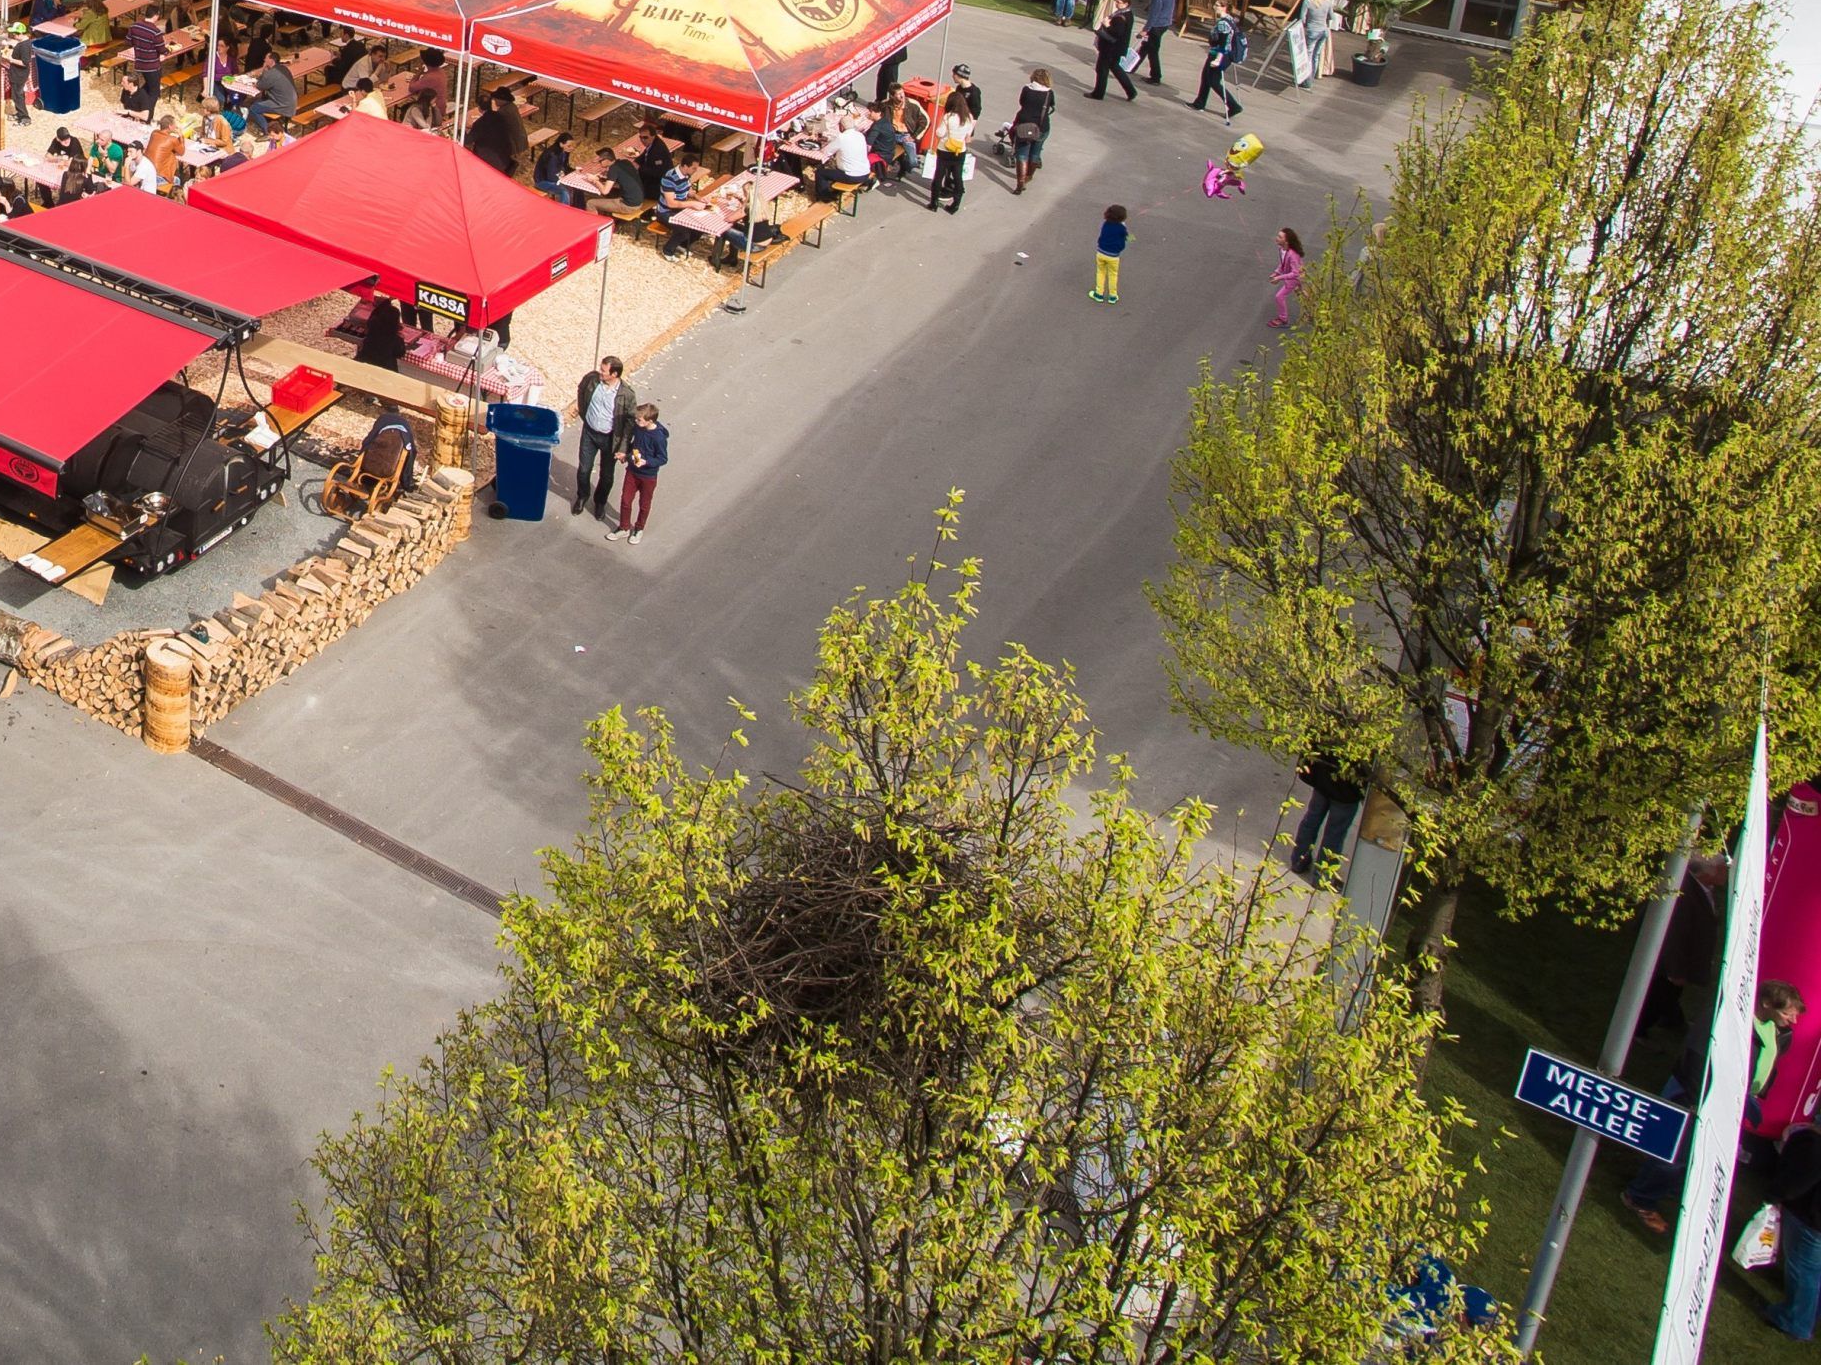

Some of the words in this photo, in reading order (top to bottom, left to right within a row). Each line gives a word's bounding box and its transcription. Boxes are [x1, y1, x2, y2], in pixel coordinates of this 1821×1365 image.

[333, 6, 453, 42] www.bbq-longhorn.at
[642, 4, 728, 30] BAR-B-Q
[682, 24, 716, 43] Time
[611, 78, 754, 124] www.bbq-longhorn.at
[418, 290, 466, 316] KASSA
[1546, 1063, 1661, 1122] MESSE-
[1549, 1092, 1644, 1144] ALLEE
